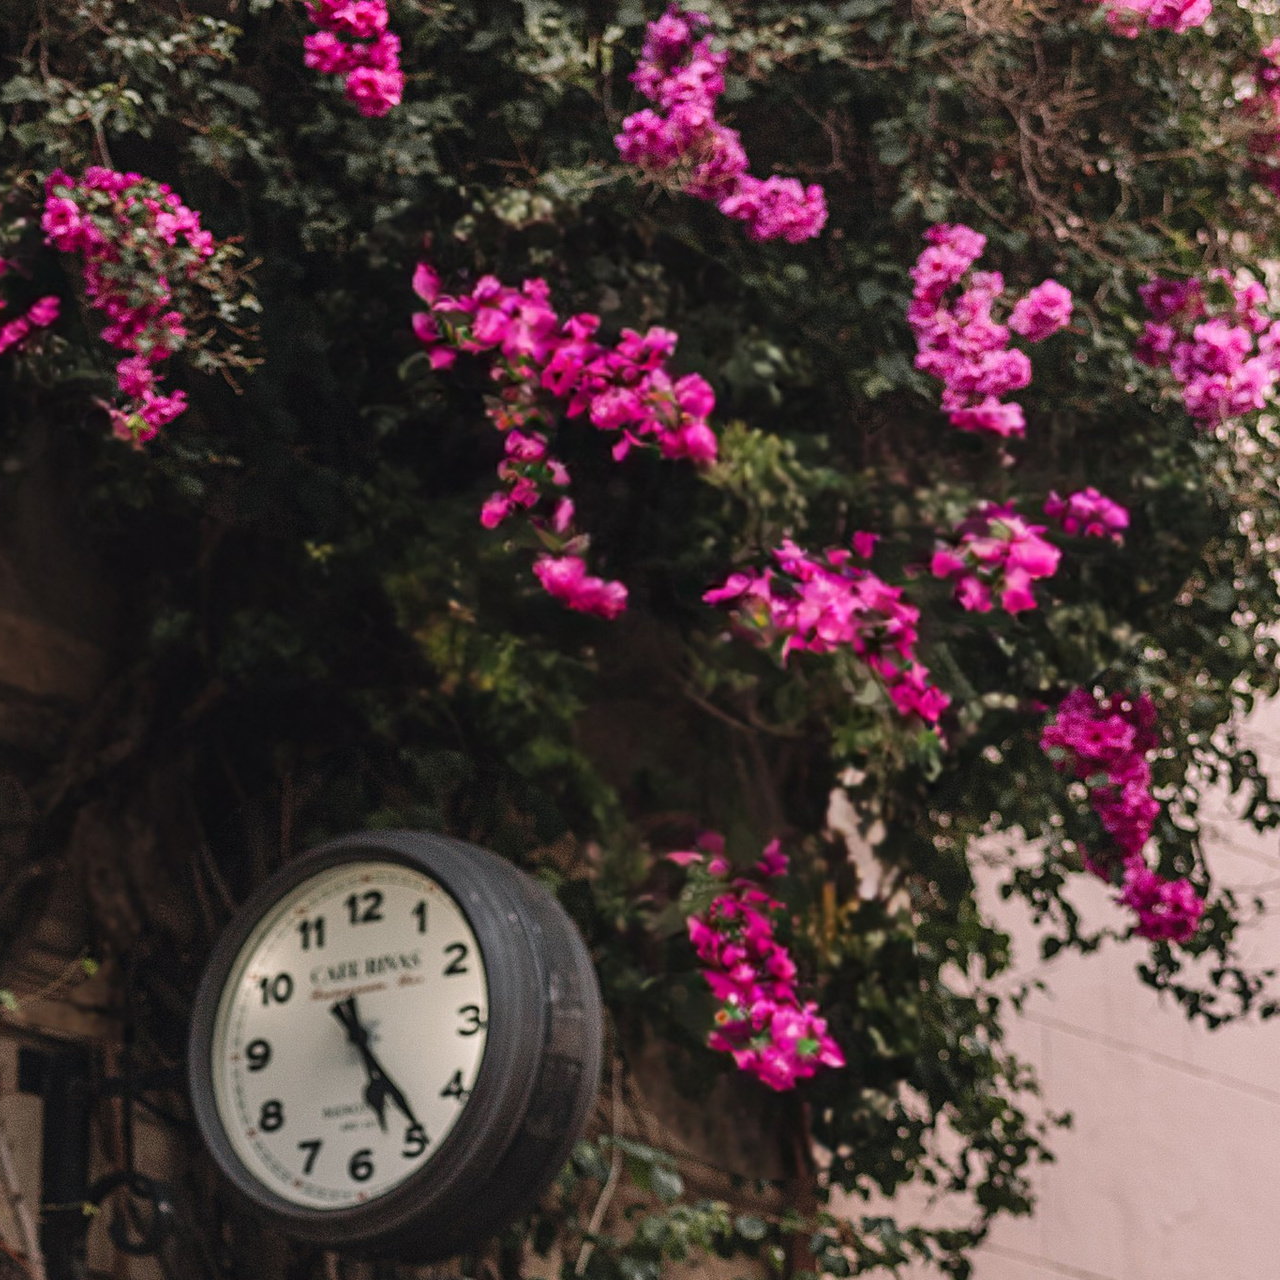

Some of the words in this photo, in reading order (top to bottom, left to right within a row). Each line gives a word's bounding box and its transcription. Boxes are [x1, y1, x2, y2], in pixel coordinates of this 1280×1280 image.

[346, 889, 383, 924] 12
[412, 901, 427, 933] 1
[297, 917, 325, 950] 11
[443, 943, 468, 976] 2
[260, 972, 294, 1008] 10
[458, 1004, 482, 1036] 3
[246, 1039, 272, 1071] 9
[440, 1070, 464, 1100] 4
[260, 1099, 284, 1133] 8
[298, 1140, 323, 1175] 7
[402, 1125, 428, 1158] 5
[348, 1149, 374, 1182] 6
